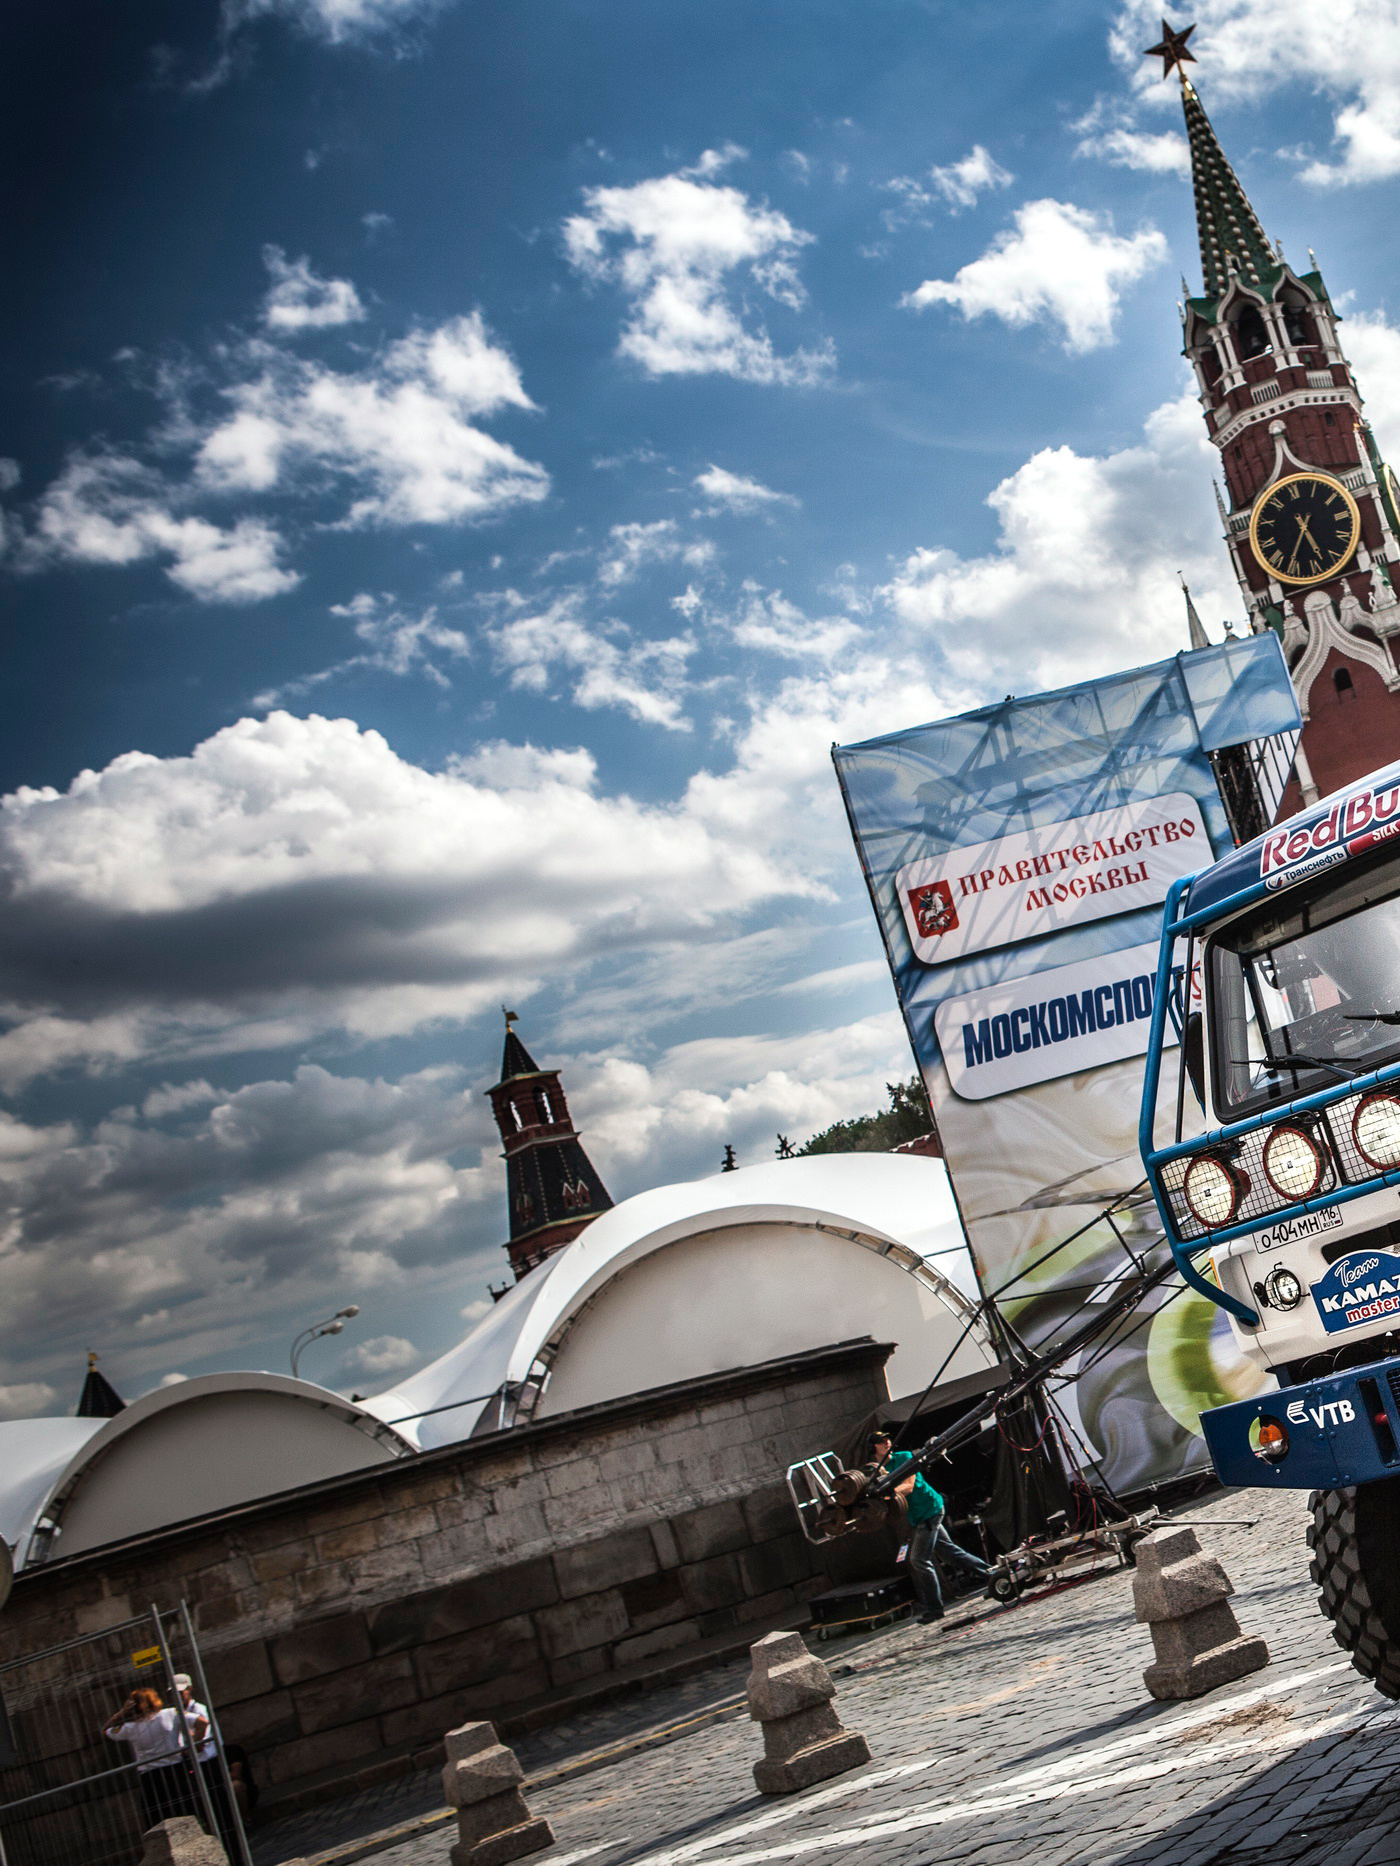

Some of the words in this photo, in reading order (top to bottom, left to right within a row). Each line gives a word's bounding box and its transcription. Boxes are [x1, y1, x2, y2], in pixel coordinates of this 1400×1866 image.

[1260, 803, 1342, 875] Red
[1372, 822, 1400, 842] SILK
[957, 818, 1196, 897] ПРАВИТЕЛЬСТВО
[1283, 850, 1345, 882] Транснефть
[1026, 861, 1151, 912] МОСКВЫ
[961, 965, 1184, 1069] МОСКОМСПО
[1322, 1220, 1335, 1229] RUS
[1334, 1257, 1380, 1288] Team
[1346, 1296, 1400, 1324] master
[1309, 1399, 1356, 1429] VTB
